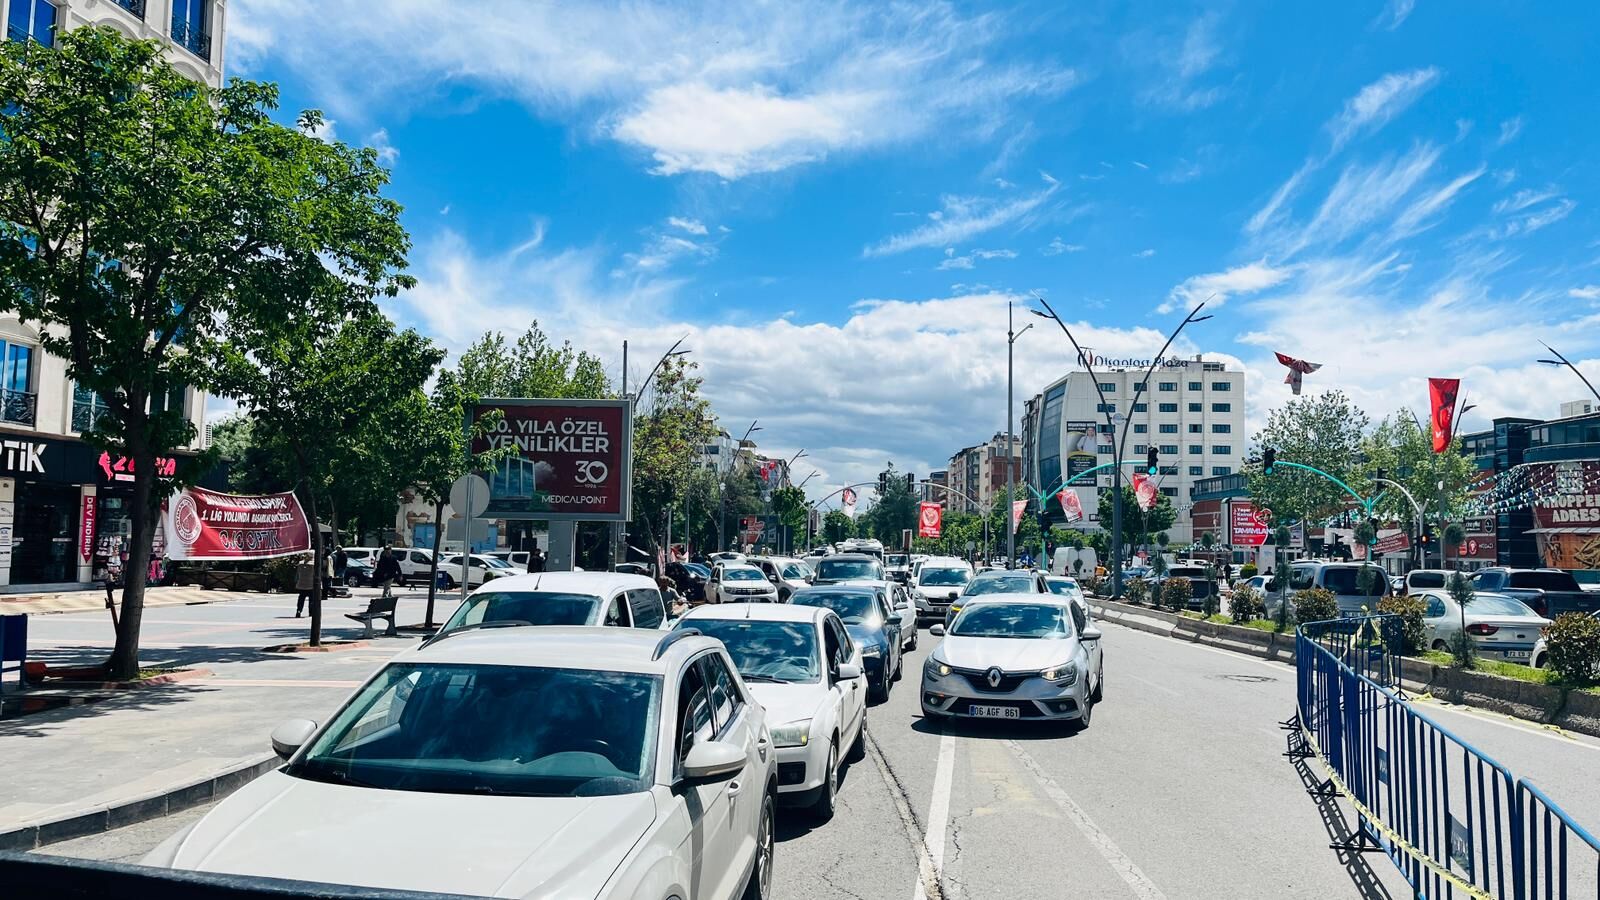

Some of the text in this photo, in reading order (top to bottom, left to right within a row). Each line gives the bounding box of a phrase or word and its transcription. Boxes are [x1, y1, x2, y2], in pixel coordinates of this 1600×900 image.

[1154, 356, 1189, 367] Plaza
[517, 420, 556, 434] YILA
[561, 418, 608, 435] ÖZEL
[541, 495, 608, 505] MEDICALPOINT
[86, 497, 94, 516] DEV
[201, 509, 209, 520] 1.
[210, 508, 222, 521] LİG
[223, 511, 250, 522] YOLUNDA
[975, 707, 1018, 717] 06 AGF 861
